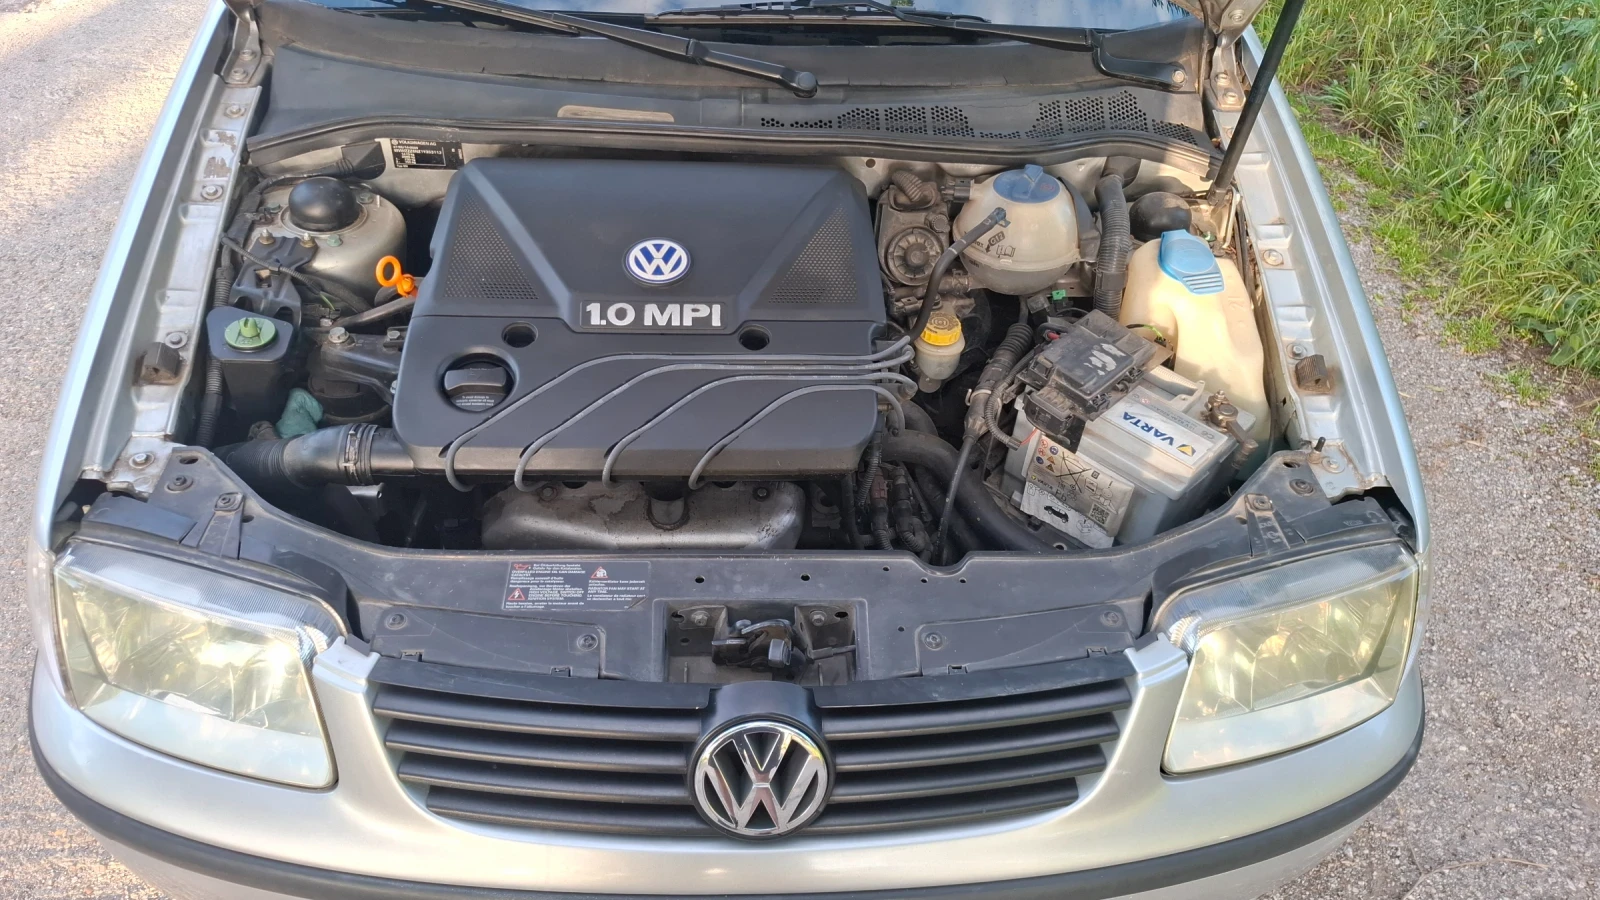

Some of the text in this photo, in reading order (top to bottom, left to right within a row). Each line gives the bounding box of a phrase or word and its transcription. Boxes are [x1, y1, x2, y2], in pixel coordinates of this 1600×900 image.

[990, 233, 1004, 245] G12
[585, 302, 721, 327] 1.0 MPI
[1123, 412, 1175, 447] VARTA
